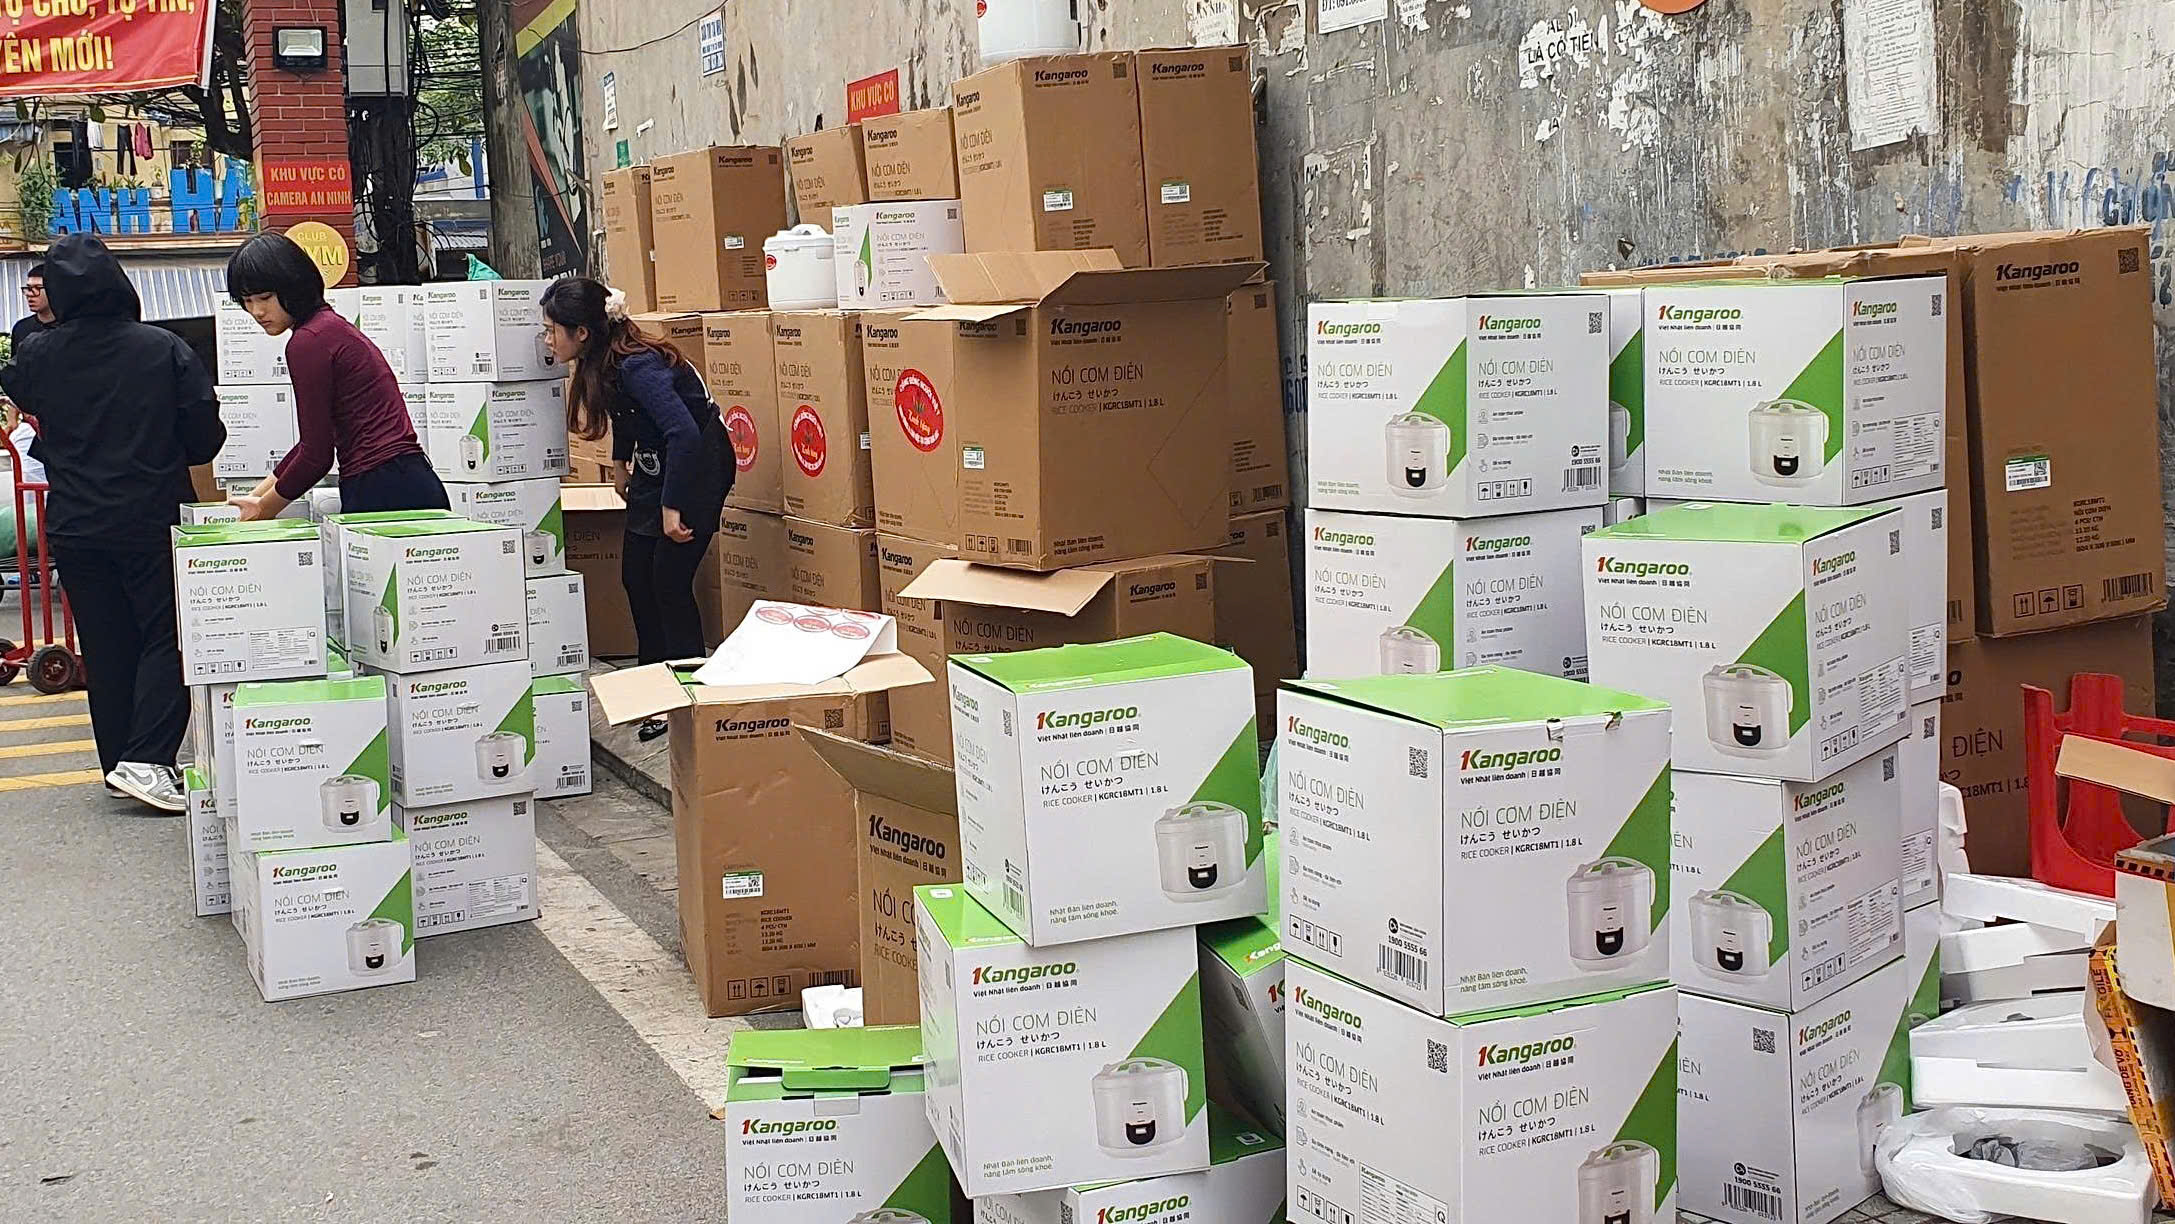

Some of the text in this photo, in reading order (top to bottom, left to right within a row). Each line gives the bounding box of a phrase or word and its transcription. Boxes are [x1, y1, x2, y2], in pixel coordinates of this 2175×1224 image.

[51, 30, 113, 71] MỚI!
[1548, 35, 1566, 59] CÓ
[1034, 69, 1088, 84] Kangaroo
[1151, 62, 1204, 75] Kangaroo
[851, 76, 894, 112] KHU VỰC CÓ
[956, 91, 980, 108] Kangaroo
[867, 129, 898, 143] Kangaroo
[718, 155, 753, 165] Kangaroo
[271, 165, 345, 184] KHU VỰC CÓ
[267, 191, 351, 205] CAMERA AN NINH
[48, 187, 150, 234] ANH
[876, 211, 915, 221] Kangaroo
[297, 232, 328, 240] CLUB
[303, 245, 343, 265] YM
[1996, 261, 2079, 281] Kangaroo
[498, 288, 530, 297] Kangaroo
[1659, 305, 1741, 323] Kangaroo
[1853, 301, 1897, 319] Kangaroo
[867, 325, 898, 340] Kangaroo
[1050, 318, 1121, 335] Kangaroo
[1318, 321, 1381, 336] Kangaroo
[1478, 315, 1540, 332] Kangaroo
[1659, 347, 1681, 364] NỒI
[1688, 349, 1718, 364] CƠM
[1052, 364, 1144, 385] NỒI CƠM ĐIỆN
[492, 390, 526, 399] Kangaroo
[476, 490, 516, 500] Kangaroo
[1315, 527, 1374, 546] Kangaroo
[1466, 535, 1531, 552] Kangaroo
[405, 546, 459, 558] Kangaroo
[188, 557, 247, 570] Kangaroo
[1597, 556, 1689, 577] Kangaroo
[1813, 550, 1856, 576] Kangaroo
[1130, 582, 1176, 597] Kangaroo
[1601, 604, 1626, 620] NỒI
[1632, 606, 1665, 622] CƠM
[410, 679, 467, 693] Kangaroo
[952, 684, 979, 712] Kangaroo
[245, 717, 311, 730] Kangaroo
[715, 717, 790, 732] Kangaroo
[1036, 705, 1139, 730] Kangaroo
[1083, 728, 1103, 737] doanh
[1288, 715, 1349, 749] Kangaroo
[1953, 728, 2003, 757] ĐIỆN
[1460, 747, 1561, 771] Kangaroo
[1041, 760, 1069, 781] NỒI
[1076, 756, 1113, 777] CƠM
[1506, 772, 1525, 780] doanh
[1042, 776, 1123, 794] けんこう せいかつ
[1289, 771, 1307, 792] NỒI
[1310, 778, 1333, 800] CƠM
[1043, 798, 1059, 808] RICE
[1062, 794, 1092, 807] COOKER
[1151, 784, 1161, 793] 1.8
[1794, 781, 1844, 811] Kangaroo
[414, 810, 467, 825] Kangaroo
[1462, 798, 1576, 829] NỒI CƠM ĐIỆN
[868, 814, 946, 859] Kangaroo
[1461, 827, 1540, 844] けんこう せいかつ
[1461, 850, 1477, 859] RICE
[1480, 847, 1509, 857] COOKER
[1516, 841, 1559, 853] KGRC18MT1
[1566, 839, 1576, 847] 1.8
[273, 863, 337, 878] Kangaroo
[1388, 935, 1403, 947] 1900
[972, 961, 1076, 986] Kangaroo
[1020, 982, 1040, 992] doanh
[1295, 986, 1362, 1030] Kangaroo
[977, 1006, 1097, 1036] NỒI CƠM ĐIỆN
[1799, 1009, 1851, 1045] Kangaroo
[977, 1031, 1060, 1049] けんこう せいかつ
[978, 1052, 995, 1062] RICE
[998, 1050, 1029, 1061] COOKER
[1035, 1044, 1081, 1056] KGRC18MT1
[1088, 1042, 1099, 1050] 1.8
[1296, 1041, 1315, 1065] NỒI
[1319, 1051, 1346, 1079] CƠM
[1478, 1036, 1574, 1067] Kangaroo
[1479, 1087, 1589, 1125] NỒI CƠM ĐIỆN
[742, 1119, 837, 1136] Kangaroo
[1479, 1116, 1556, 1141] けんこう せいかつ
[745, 1159, 854, 1179] NỒI CƠM ĐIỆN
[1098, 1195, 1189, 1224] Kangaroo
